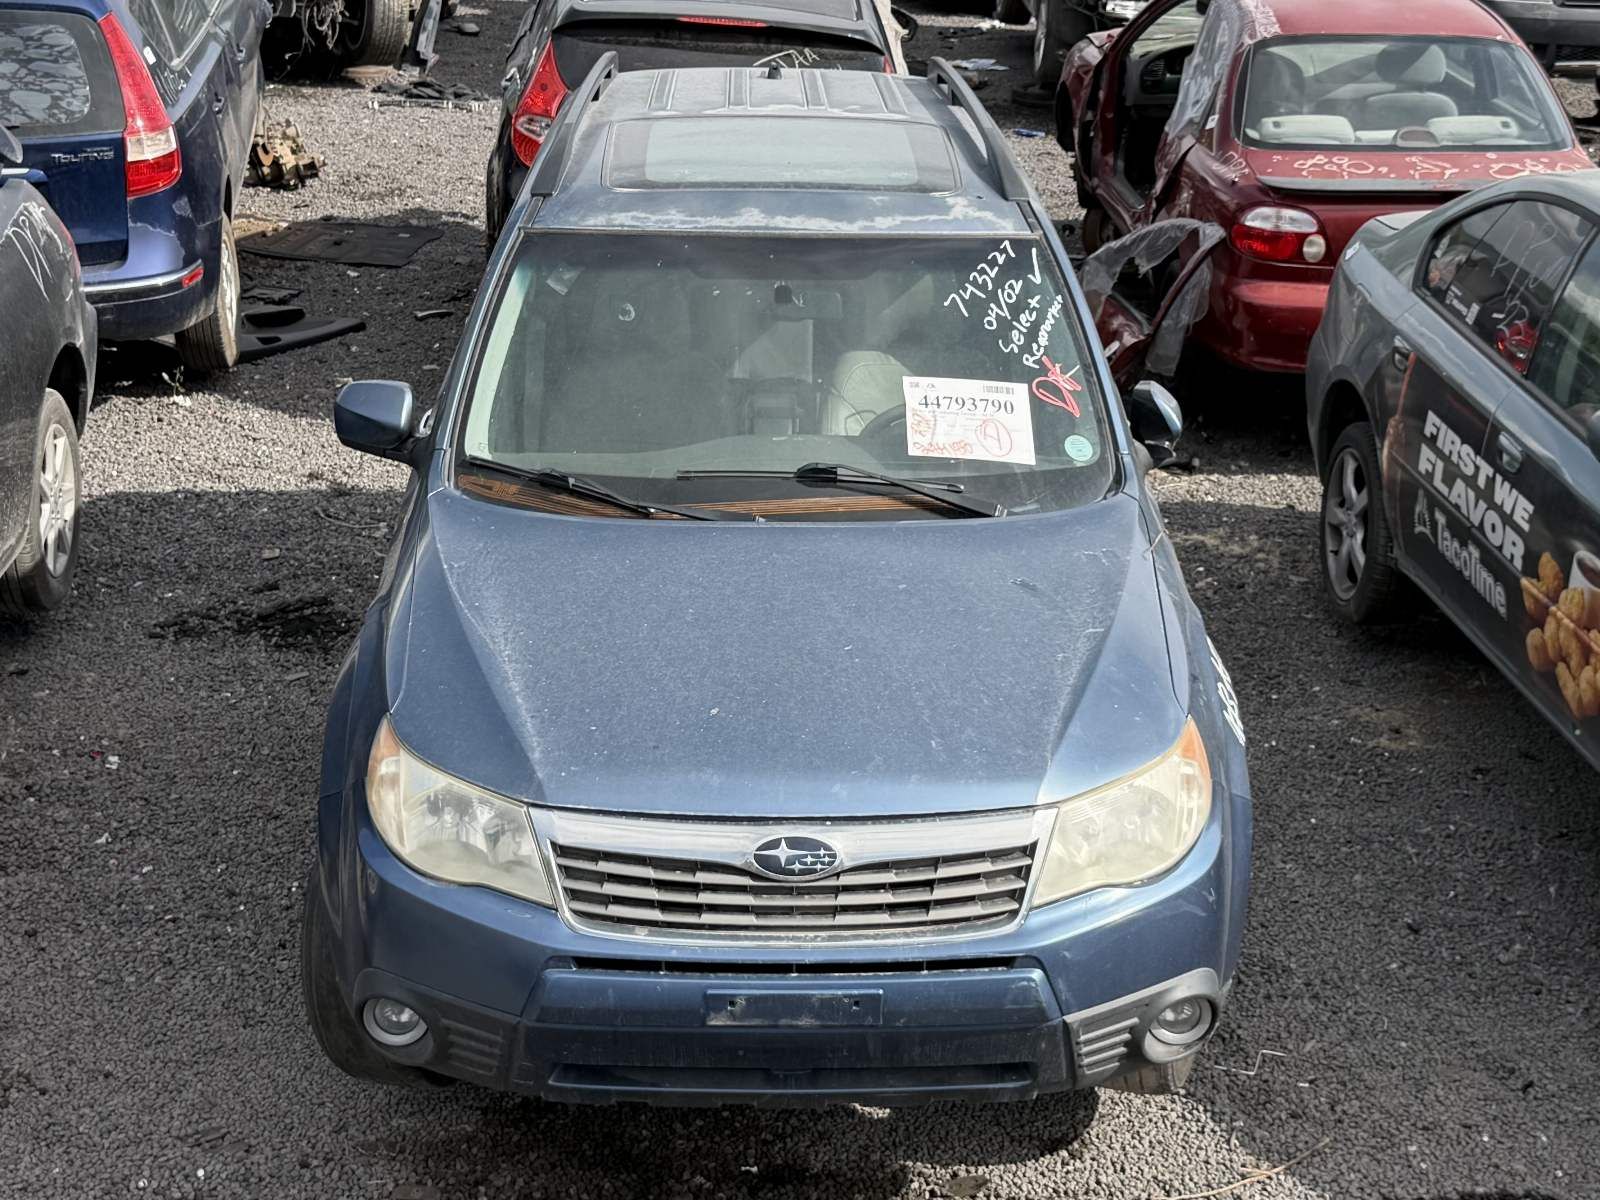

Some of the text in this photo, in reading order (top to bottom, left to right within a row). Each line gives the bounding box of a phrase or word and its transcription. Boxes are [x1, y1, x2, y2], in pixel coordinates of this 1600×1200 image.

[944, 239, 1015, 317] 743227
[984, 279, 1023, 330] 04/02
[998, 294, 1041, 354] Select
[918, 394, 1014, 415] 44793790
[1424, 409, 1535, 533] FIRST WE
[1418, 443, 1525, 572] FLAVOR
